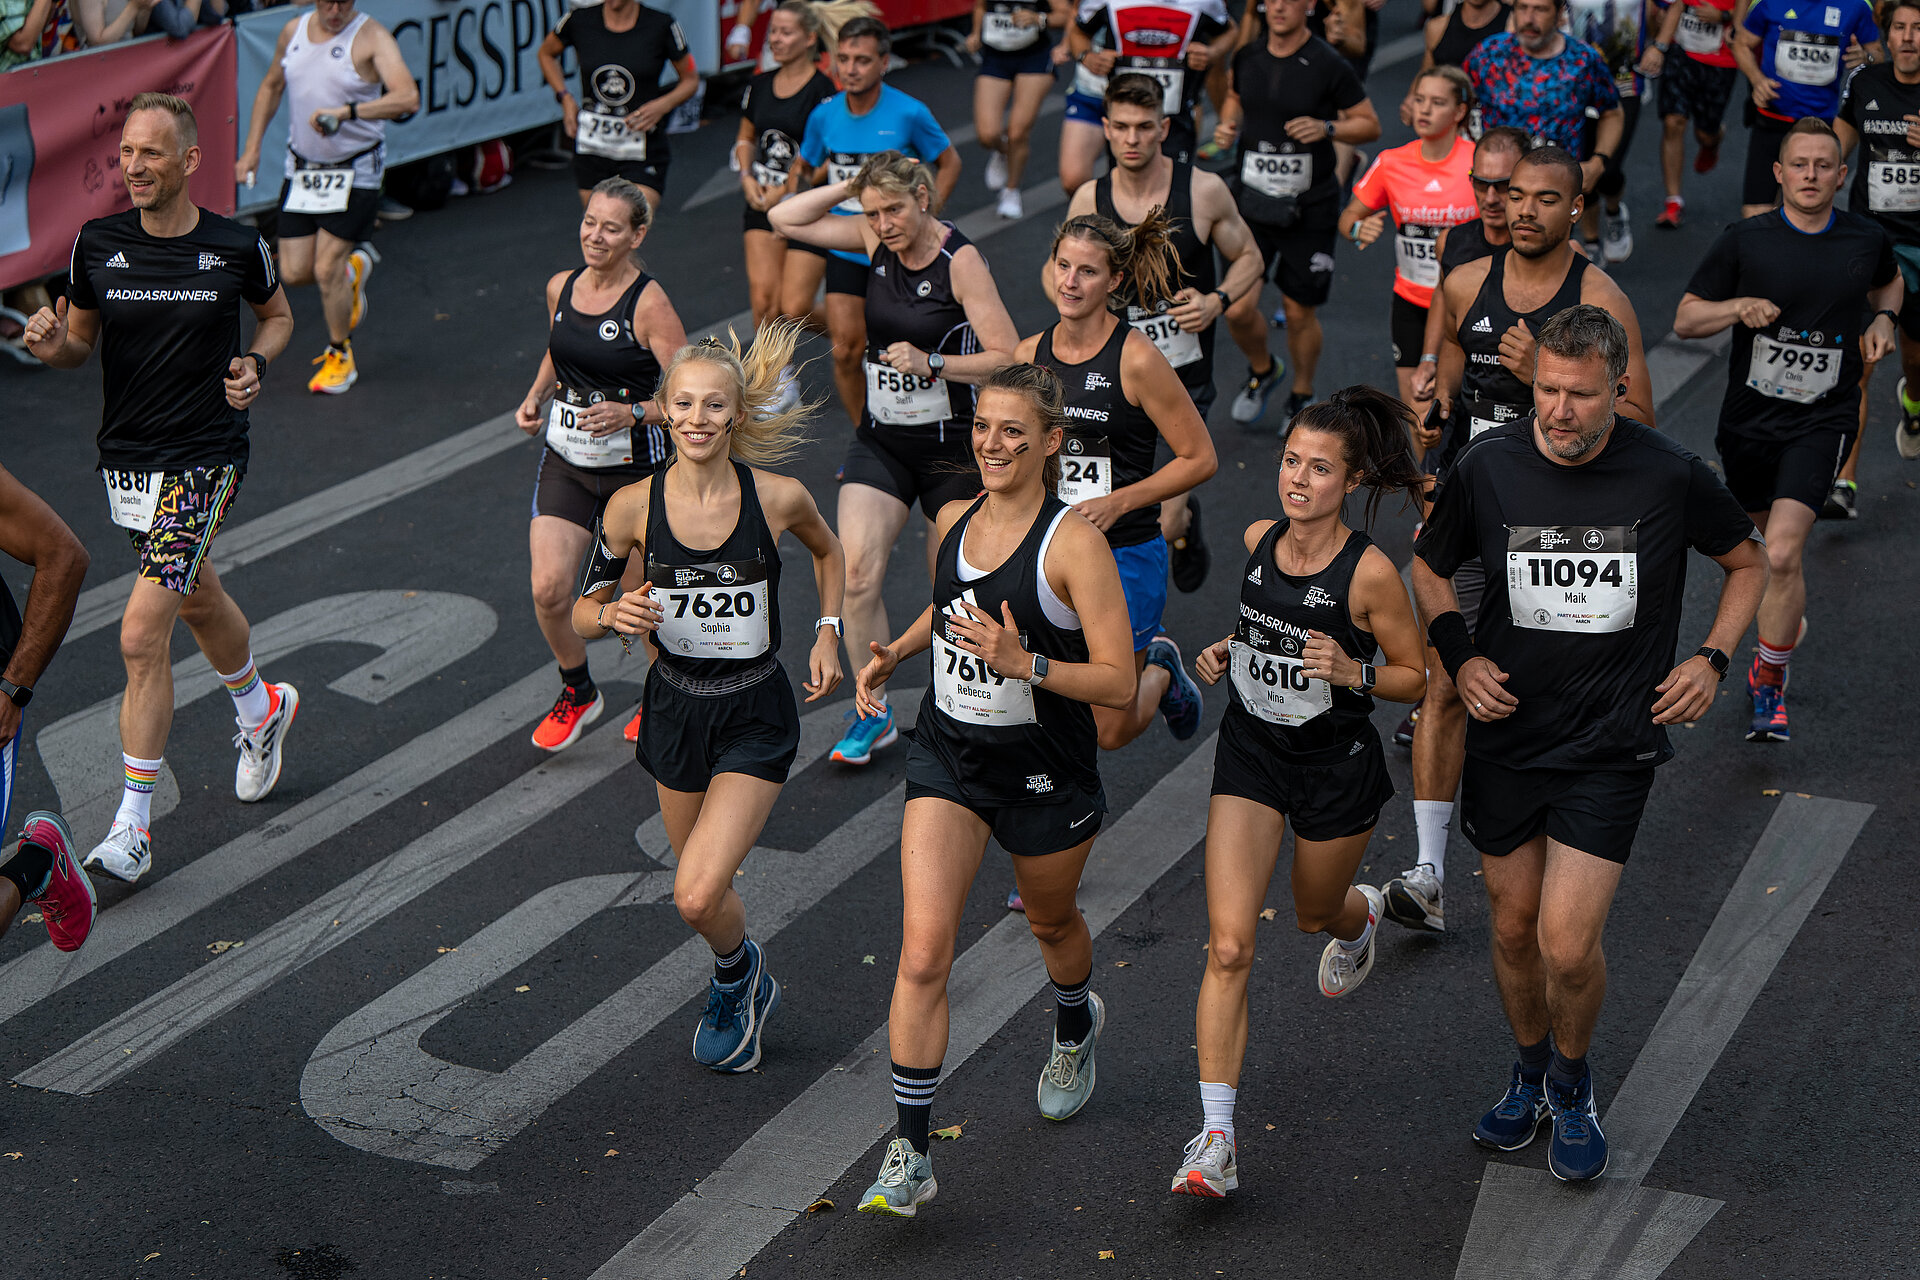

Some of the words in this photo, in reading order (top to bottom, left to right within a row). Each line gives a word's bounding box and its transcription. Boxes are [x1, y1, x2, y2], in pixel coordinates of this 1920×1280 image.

[1255, 159, 1302, 174] 9062
[302, 174, 345, 190] 5872
[106, 261, 130, 269] adidas
[198, 259, 227, 267] NIGHT
[106, 289, 218, 302] #ADIDASRUNNERS
[1767, 345, 1829, 373] 7993
[878, 370, 933, 392] F588
[1785, 371, 1803, 382] Chris
[1085, 379, 1112, 388] NIGHT
[1060, 461, 1099, 484] 24
[1528, 559, 1622, 587] 11094
[1248, 575, 1262, 586] adidas
[1305, 593, 1336, 607] NIGHT
[1308, 588, 1331, 599] CITY
[1564, 592, 1587, 604] Maik
[669, 591, 756, 619] 7620
[1302, 599, 1316, 608] 22
[700, 622, 731, 634] Sophia
[1240, 602, 1313, 642] DIDASRUNNE
[1248, 654, 1310, 692] 6610
[957, 684, 992, 700] Rebecca
[1267, 690, 1285, 704] Nina
[1026, 780, 1052, 789] NIGHT
[1029, 775, 1048, 784] CITY
[1035, 785, 1053, 793] 2021
